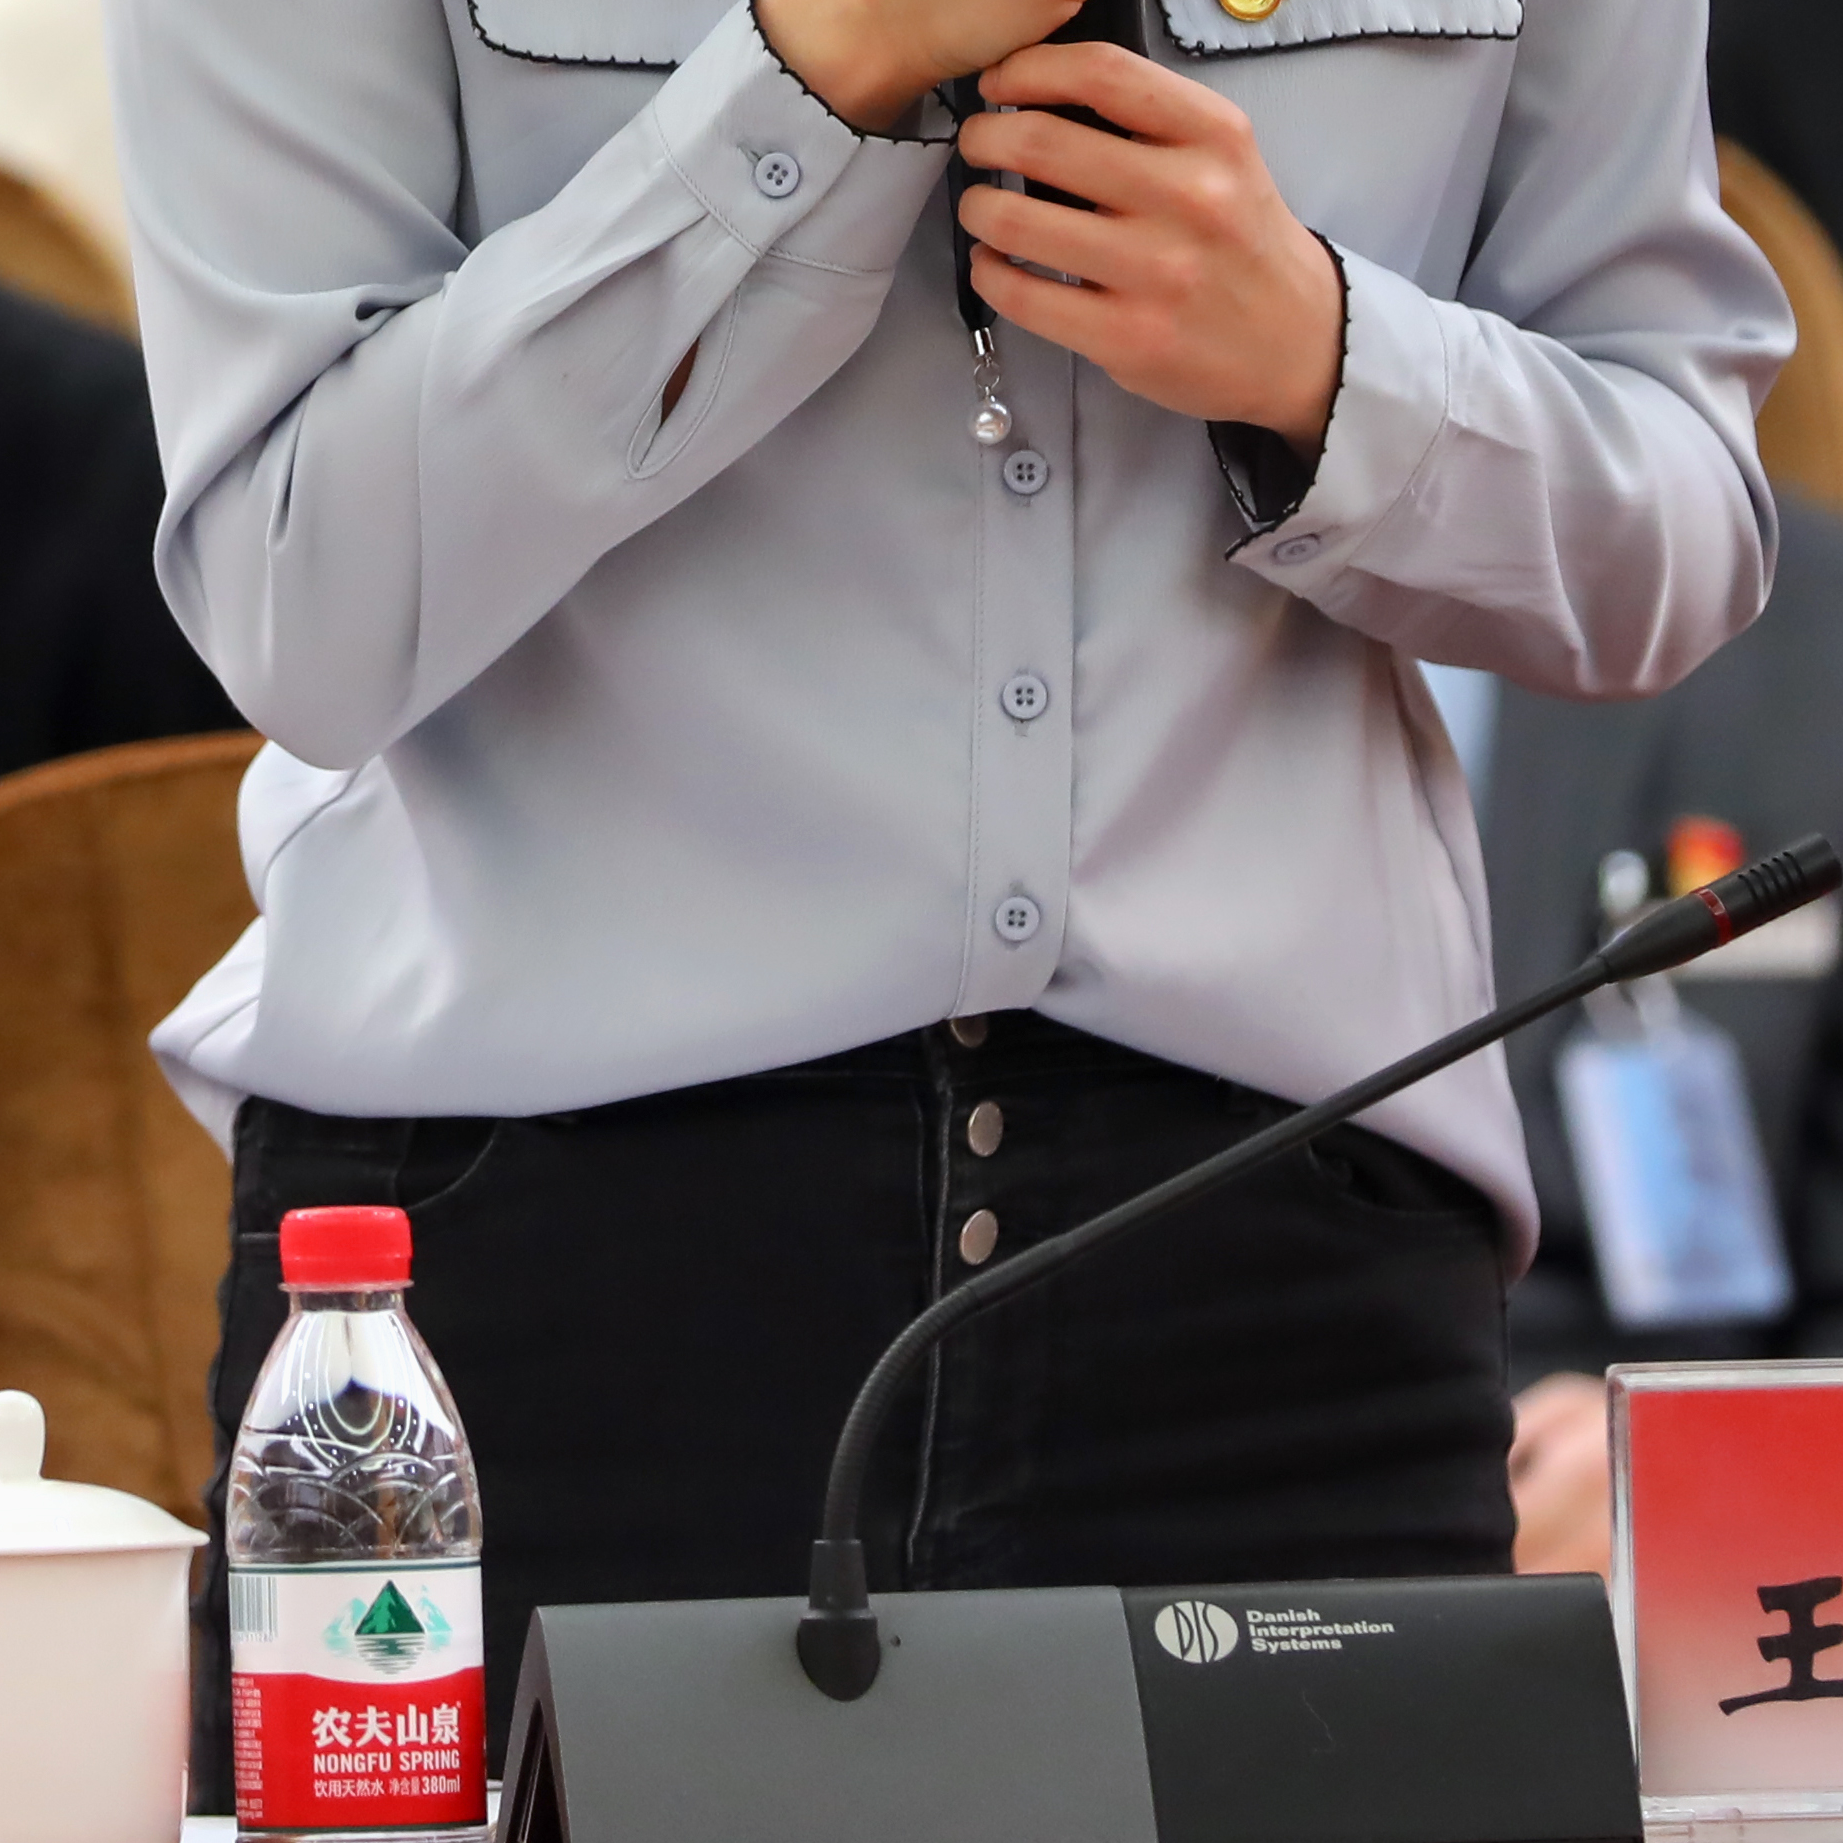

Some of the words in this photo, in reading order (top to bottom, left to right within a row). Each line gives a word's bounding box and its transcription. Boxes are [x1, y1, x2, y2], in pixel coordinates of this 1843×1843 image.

[1246, 1608, 1321, 1623] Danish
[1249, 1620, 1395, 1638] Interpretation
[1252, 1637, 1343, 1654] Systems
[311, 1703, 460, 1748] 农夫山泉
[313, 1752, 392, 1774] NONGFU
[399, 1749, 460, 1772] SPRING
[313, 1778, 385, 1798] 饮用天然水
